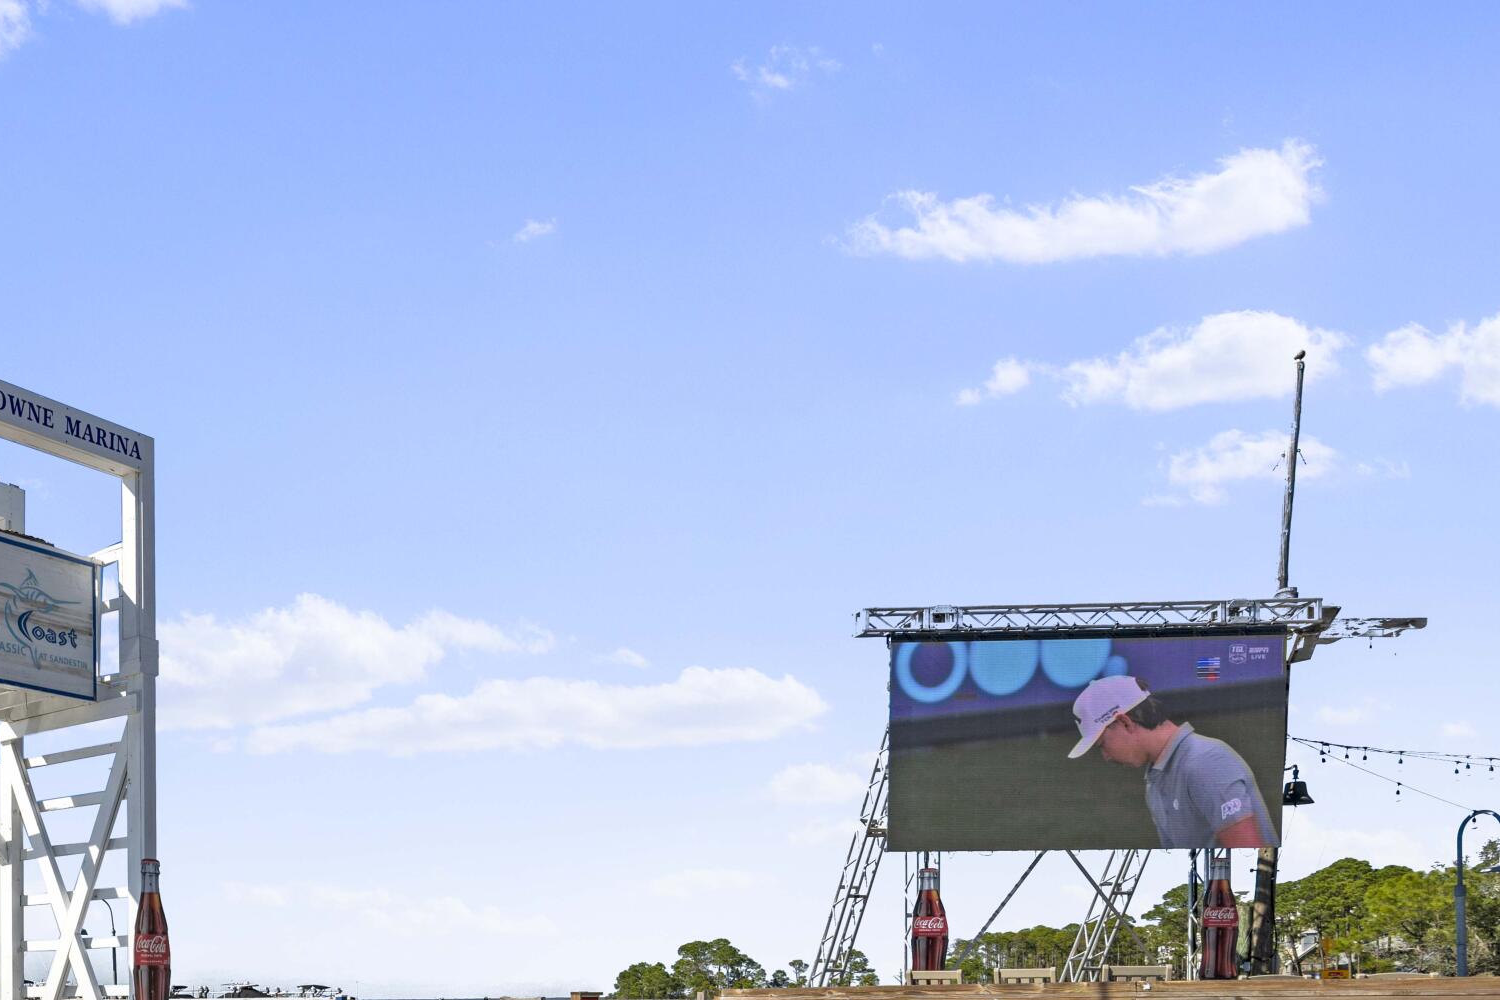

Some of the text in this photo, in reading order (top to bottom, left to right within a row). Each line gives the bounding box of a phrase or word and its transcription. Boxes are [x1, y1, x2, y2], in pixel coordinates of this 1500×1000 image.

[65, 415, 142, 460] MARINA
[18, 610, 77, 649] Coast
[39, 653, 48, 661] AT
[49, 655, 88, 670] SANDESTIN
[1204, 906, 1235, 920] Coca-Cola
[914, 916, 944, 929] Coca-Cola
[135, 935, 166, 953] Coca-Cola
